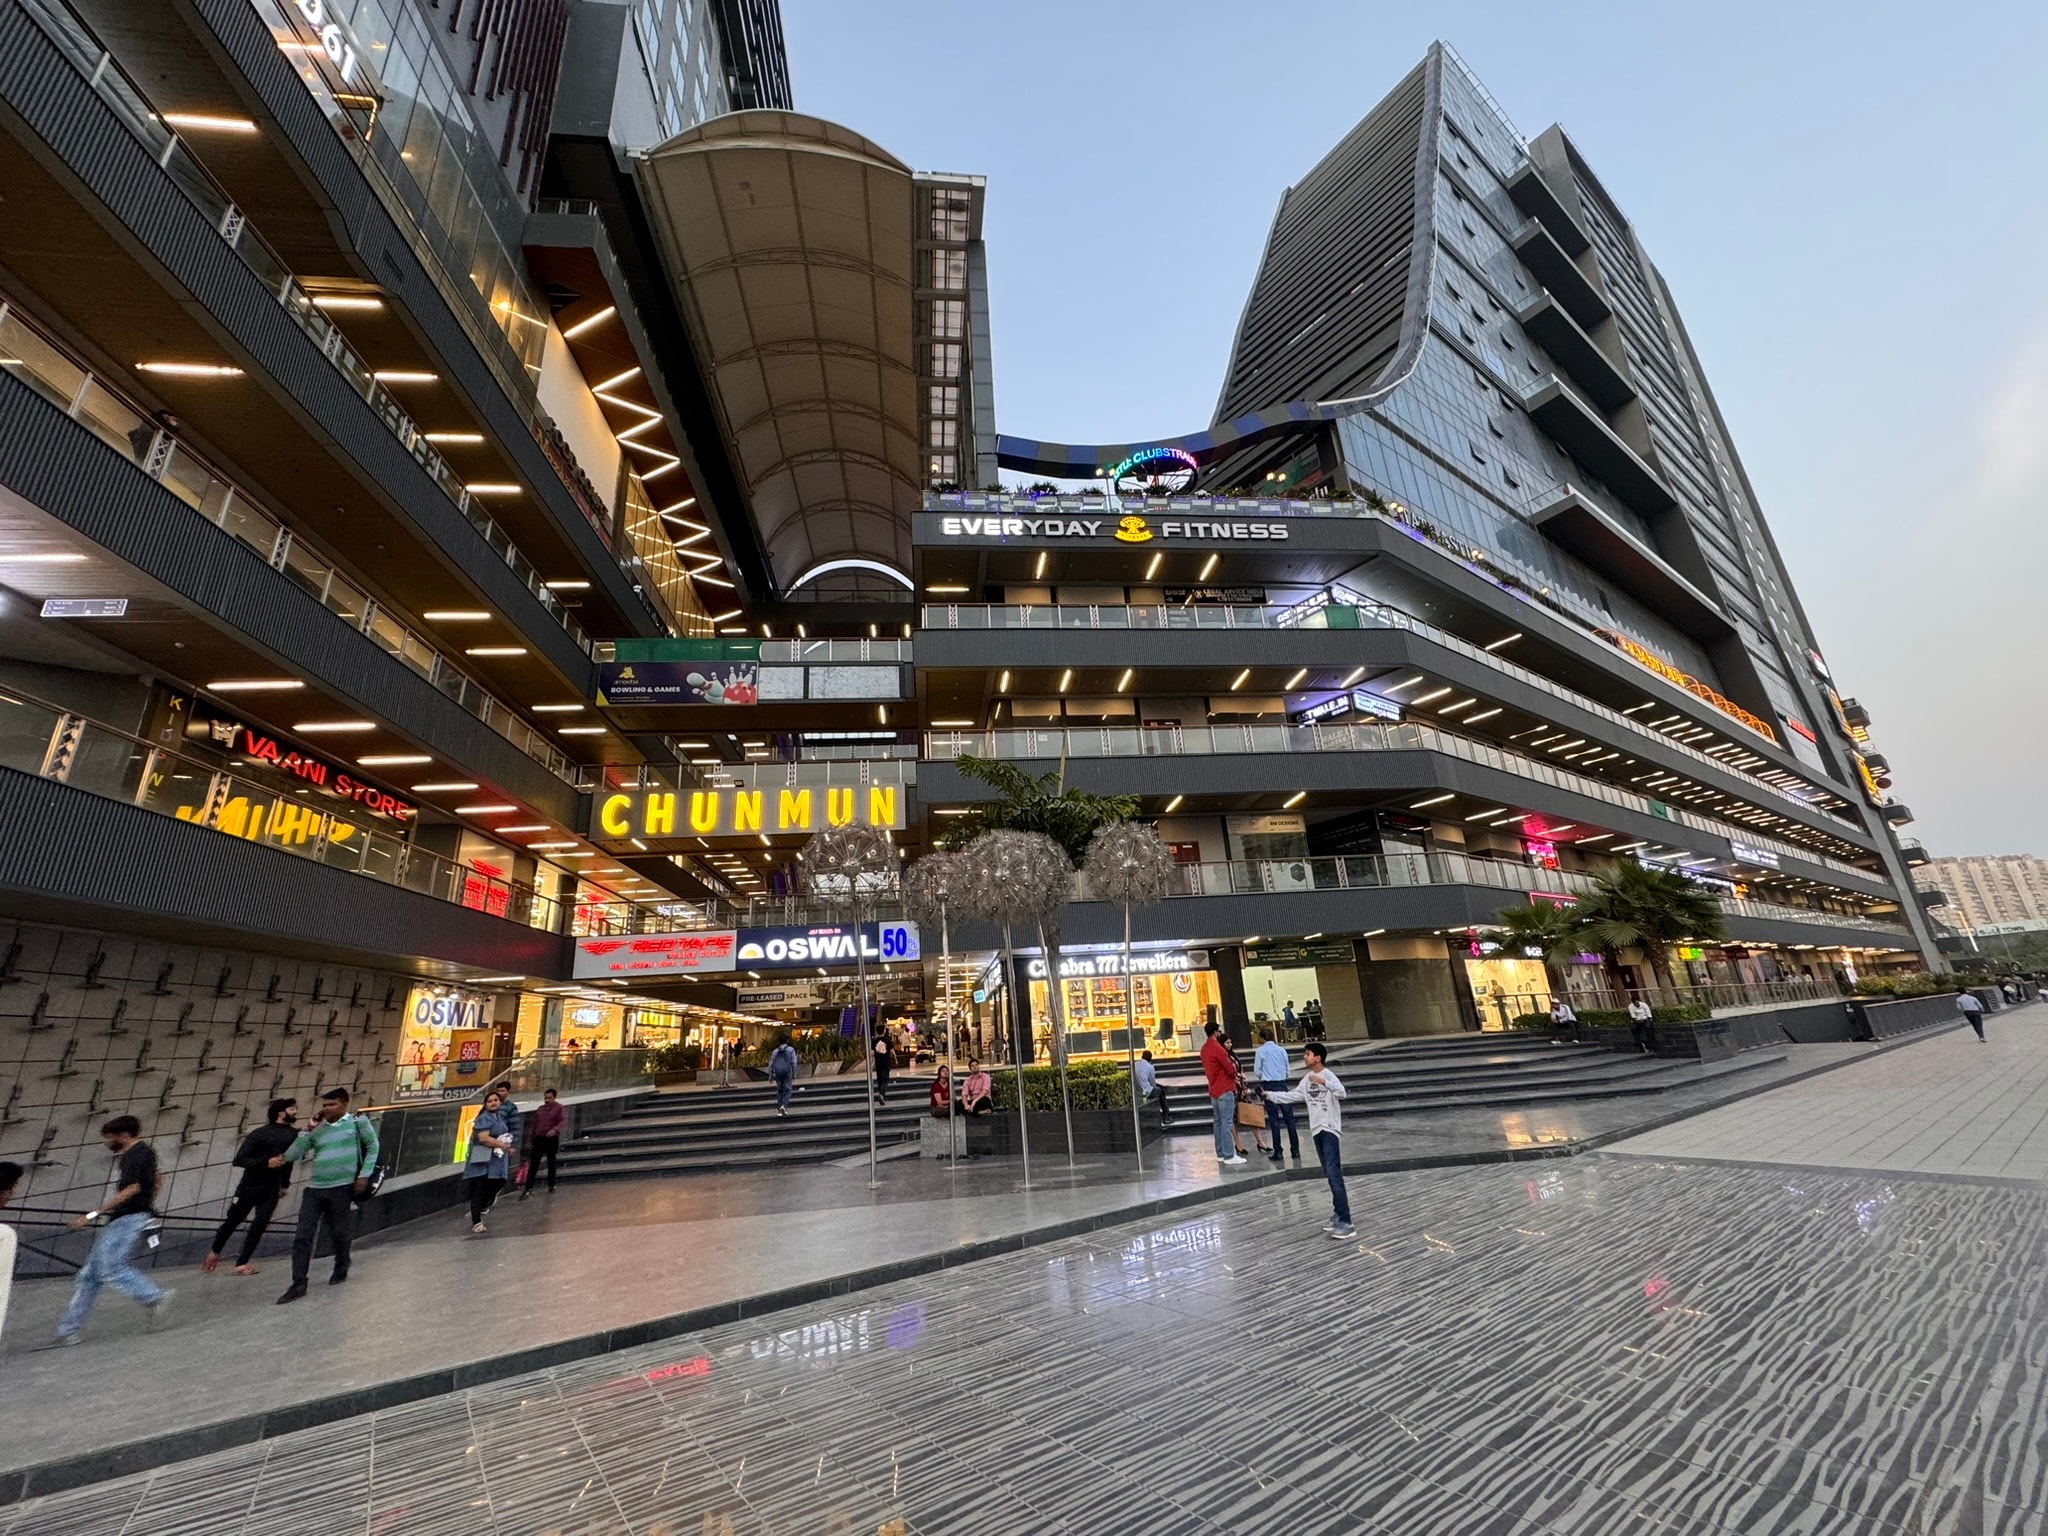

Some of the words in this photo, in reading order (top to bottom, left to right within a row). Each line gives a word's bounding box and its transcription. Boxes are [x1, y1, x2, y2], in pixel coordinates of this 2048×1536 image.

[942, 517, 1102, 537] EVERYDAY
[1162, 521, 1290, 541] FITNESS
[611, 686, 646, 694] BOWLING
[654, 686, 681, 694] GAMES
[244, 729, 327, 786] VAANI
[333, 774, 410, 822] STORE
[601, 786, 895, 836] CHUNMUN
[699, 949, 731, 958] OUTLET
[765, 934, 879, 961] OSWAL
[1095, 954, 1121, 974] 777
[740, 993, 784, 1003] PRE-LEASED
[786, 992, 809, 1000] SPACE
[415, 997, 489, 1029] OSWAL
